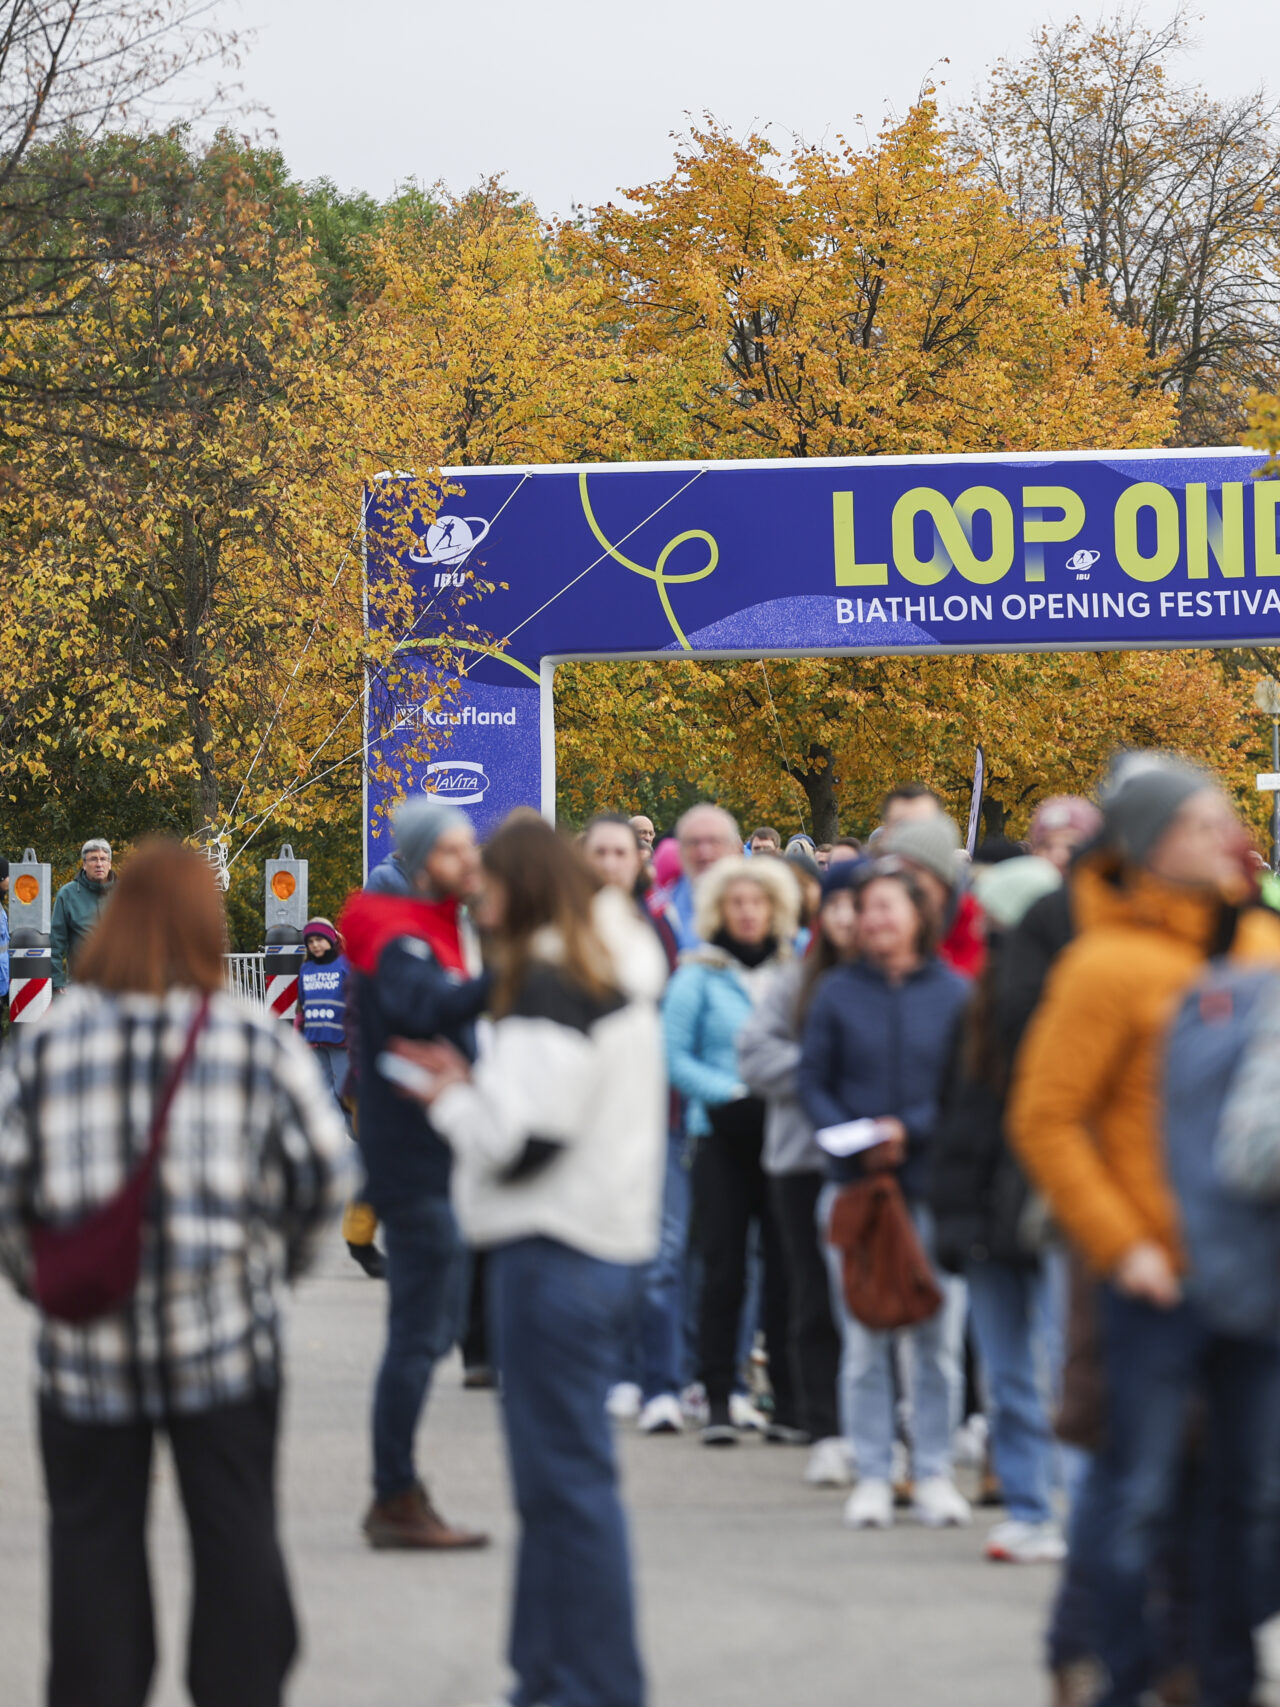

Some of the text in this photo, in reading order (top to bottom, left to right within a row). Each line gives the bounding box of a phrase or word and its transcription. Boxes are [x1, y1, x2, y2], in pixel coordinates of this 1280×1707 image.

[833, 485, 1086, 586] LOOP
[433, 572, 466, 588] IBU
[1076, 573, 1090, 581] IBU
[836, 595, 993, 624] BIATHLON
[1002, 592, 1150, 620] OPENING
[422, 706, 516, 726] Kaufland
